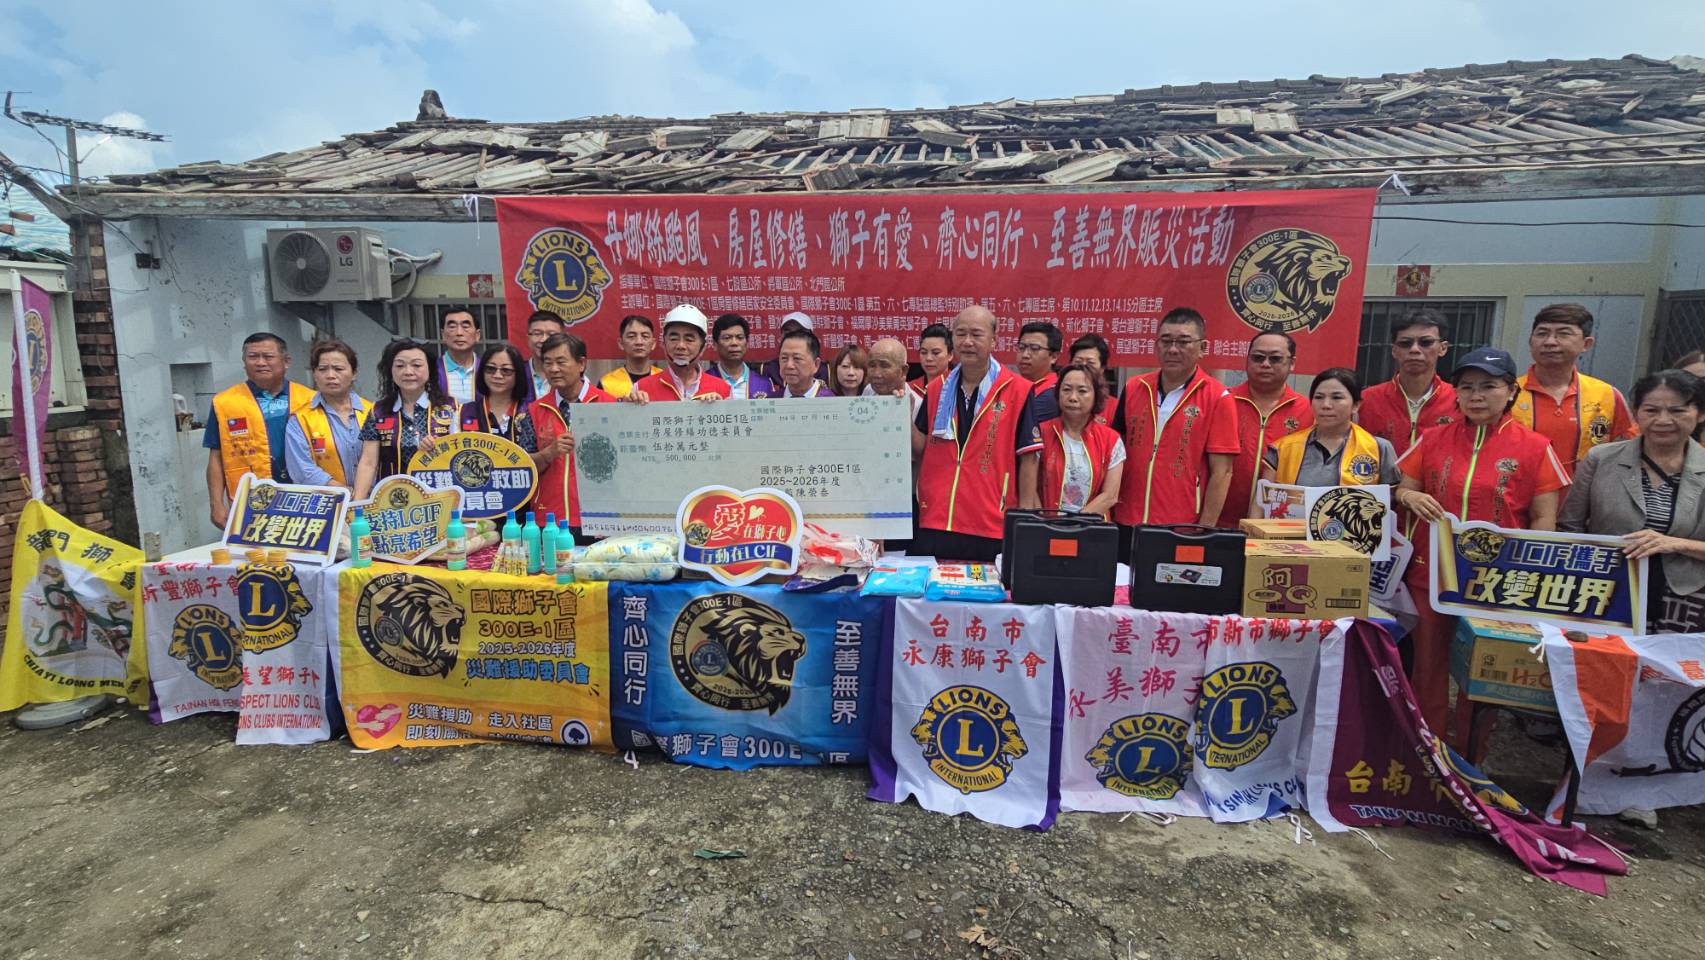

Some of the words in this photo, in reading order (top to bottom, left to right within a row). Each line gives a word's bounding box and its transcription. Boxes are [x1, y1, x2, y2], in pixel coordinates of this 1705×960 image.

[535, 233, 585, 254] LIONS
[340, 257, 353, 267] LG
[552, 260, 578, 291] L
[652, 413, 750, 426] 國際獅子會300E1區
[490, 469, 531, 489] 救助
[760, 464, 862, 475] 國際獅子會300E1區
[463, 491, 504, 511] 員會
[241, 513, 328, 548] 改變世界
[368, 502, 442, 532] 支持LCIF
[371, 525, 439, 554] 點亮希望
[247, 581, 277, 617] L
[470, 588, 578, 616] 國際獅子會
[1462, 566, 1616, 616] 改變世界
[181, 607, 226, 626] LIONS
[479, 618, 576, 640] 300E-1區
[929, 612, 1025, 646] 台南市
[198, 631, 226, 662] L
[242, 628, 294, 646] RNATIONAL
[478, 641, 576, 658] 2025-2026年度
[623, 596, 649, 706] 齊心同行
[23, 654, 56, 682] CHIAYI
[465, 658, 591, 685] 災難援助委員會
[831, 619, 862, 725] 至善無界
[902, 639, 1047, 679] 永康獅子會
[1205, 665, 1273, 695] LIONS
[240, 694, 274, 711] SPECT
[274, 694, 300, 709] LIONS
[937, 688, 1004, 717] LIONS
[1229, 697, 1255, 735] L
[253, 714, 276, 730] CLUBS
[407, 703, 473, 725] 災難援助
[488, 712, 554, 732] 走入社區
[1120, 715, 1187, 738] LIONS
[956, 718, 985, 757] L
[1209, 737, 1267, 764] TERNATIONAL
[935, 761, 999, 786] INTERNATIONAL
[1133, 746, 1161, 773] L
